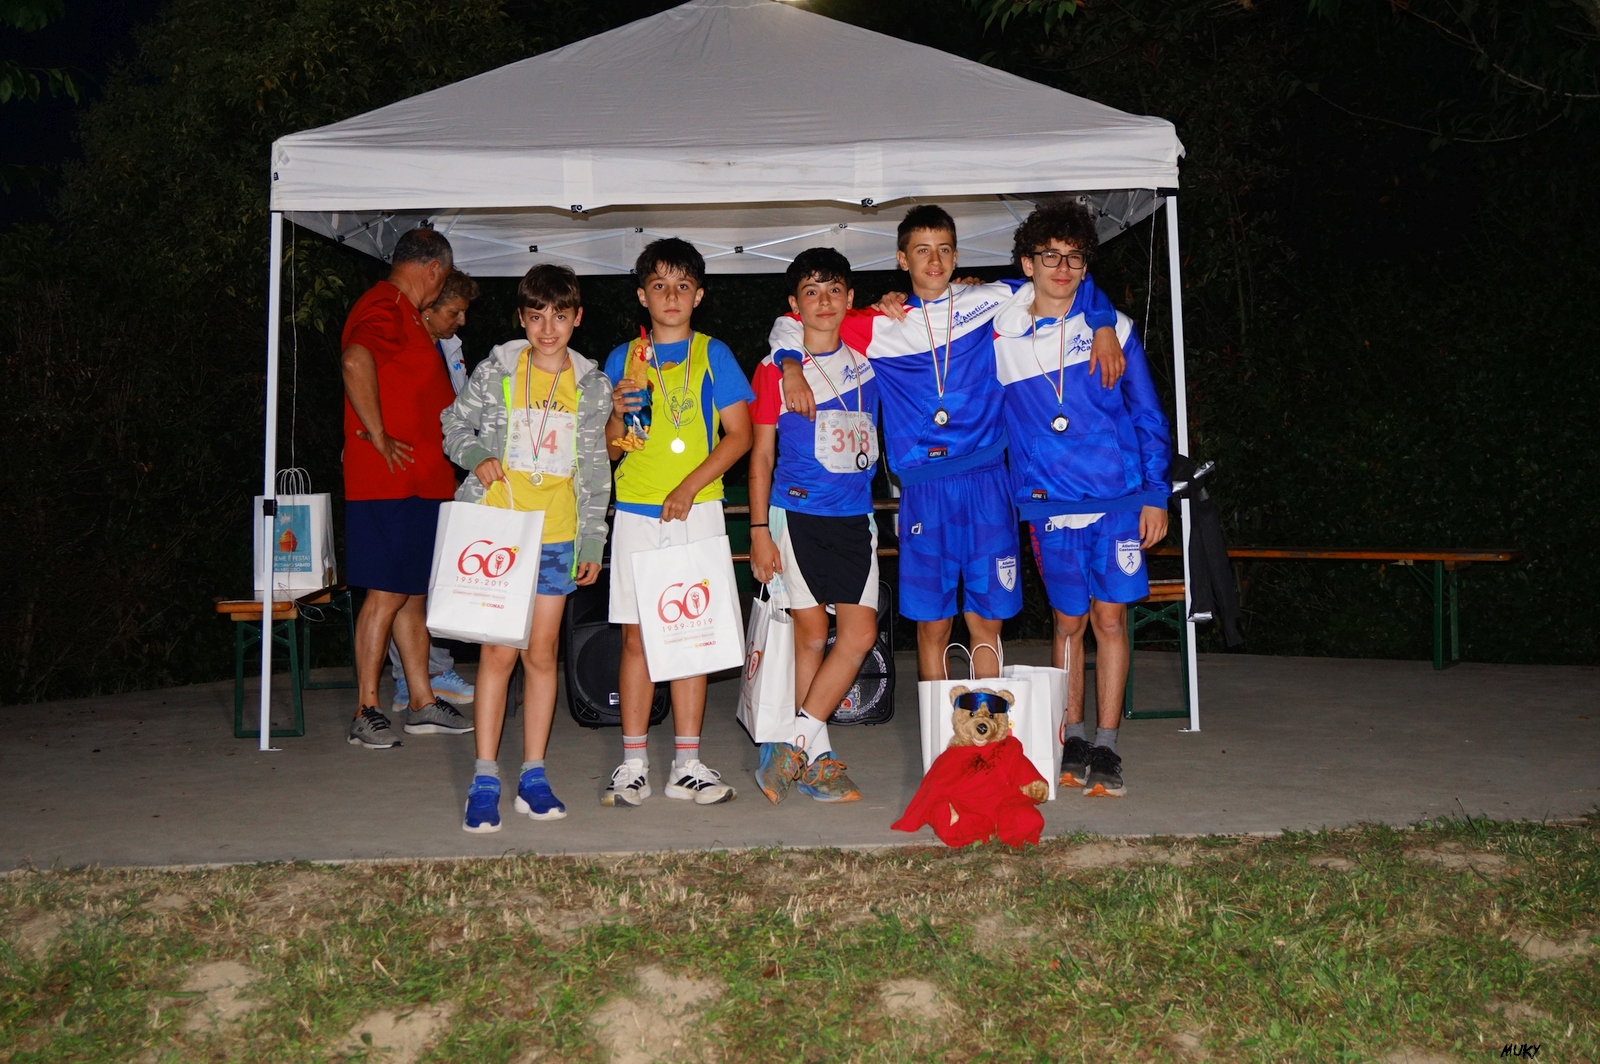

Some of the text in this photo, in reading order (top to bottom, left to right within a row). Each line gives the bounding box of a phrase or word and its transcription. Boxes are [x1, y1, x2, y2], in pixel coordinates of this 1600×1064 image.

[962, 300, 989, 321] Atletica
[541, 429, 558, 454] 4
[831, 428, 870, 453] 318
[457, 539, 517, 578] 60
[455, 576, 509, 587] 1959-2019
[486, 602, 505, 610] CONAD
[657, 582, 710, 624] 60
[662, 617, 713, 633] 1959-2019
[699, 640, 717, 648] CONAD
